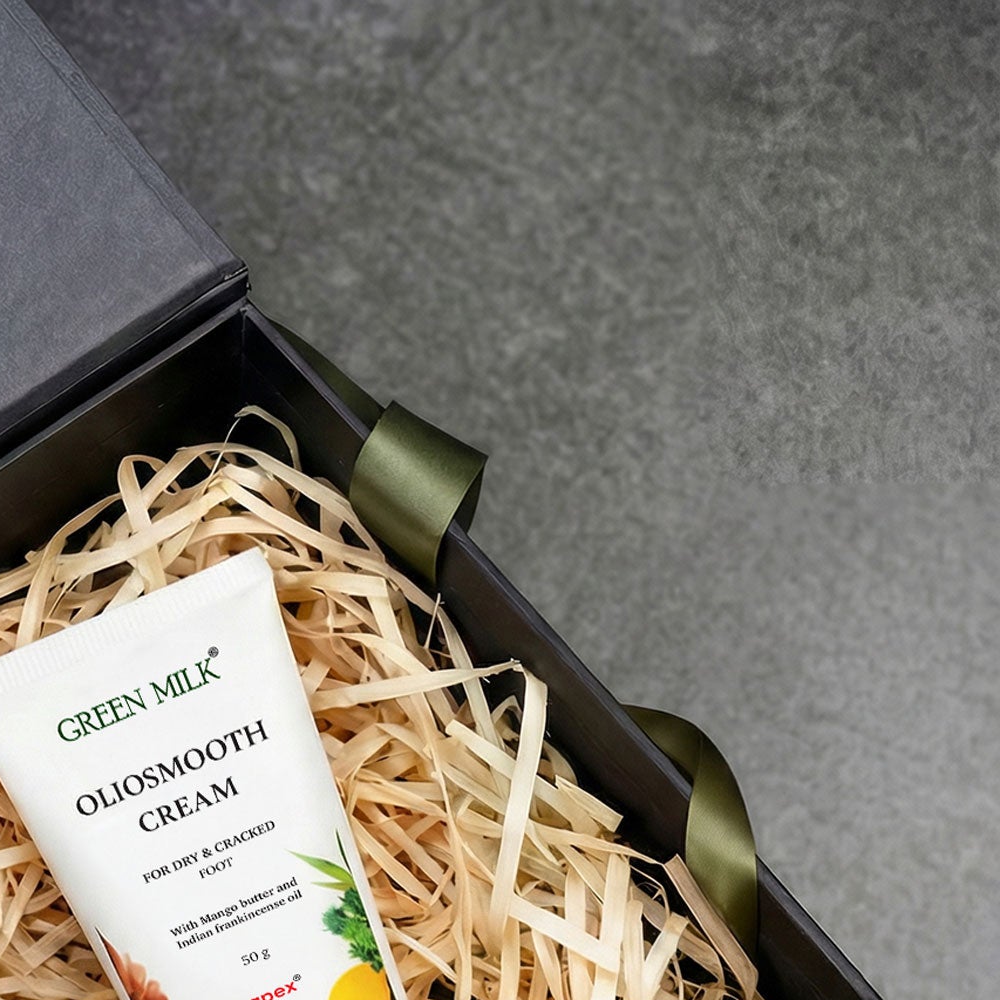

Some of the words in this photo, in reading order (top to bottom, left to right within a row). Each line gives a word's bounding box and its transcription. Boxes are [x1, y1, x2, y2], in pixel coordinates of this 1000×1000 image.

[57, 688, 147, 742] GREEN
[76, 719, 270, 816] OLIOSMOOTH
[139, 777, 240, 832] CREAM
[143, 865, 172, 884] FOR
[172, 851, 200, 872] DRY
[202, 848, 213, 858] &
[214, 820, 276, 852] CRACKED
[199, 857, 234, 879] FOOT
[170, 919, 200, 938] With
[199, 904, 239, 926] Mango
[239, 888, 274, 909] butter
[277, 876, 299, 893] and
[176, 928, 214, 950] Indian
[214, 898, 286, 934] frankincense
[287, 889, 303, 904] oil
[241, 951, 259, 966] 50
[262, 948, 271, 960] g
